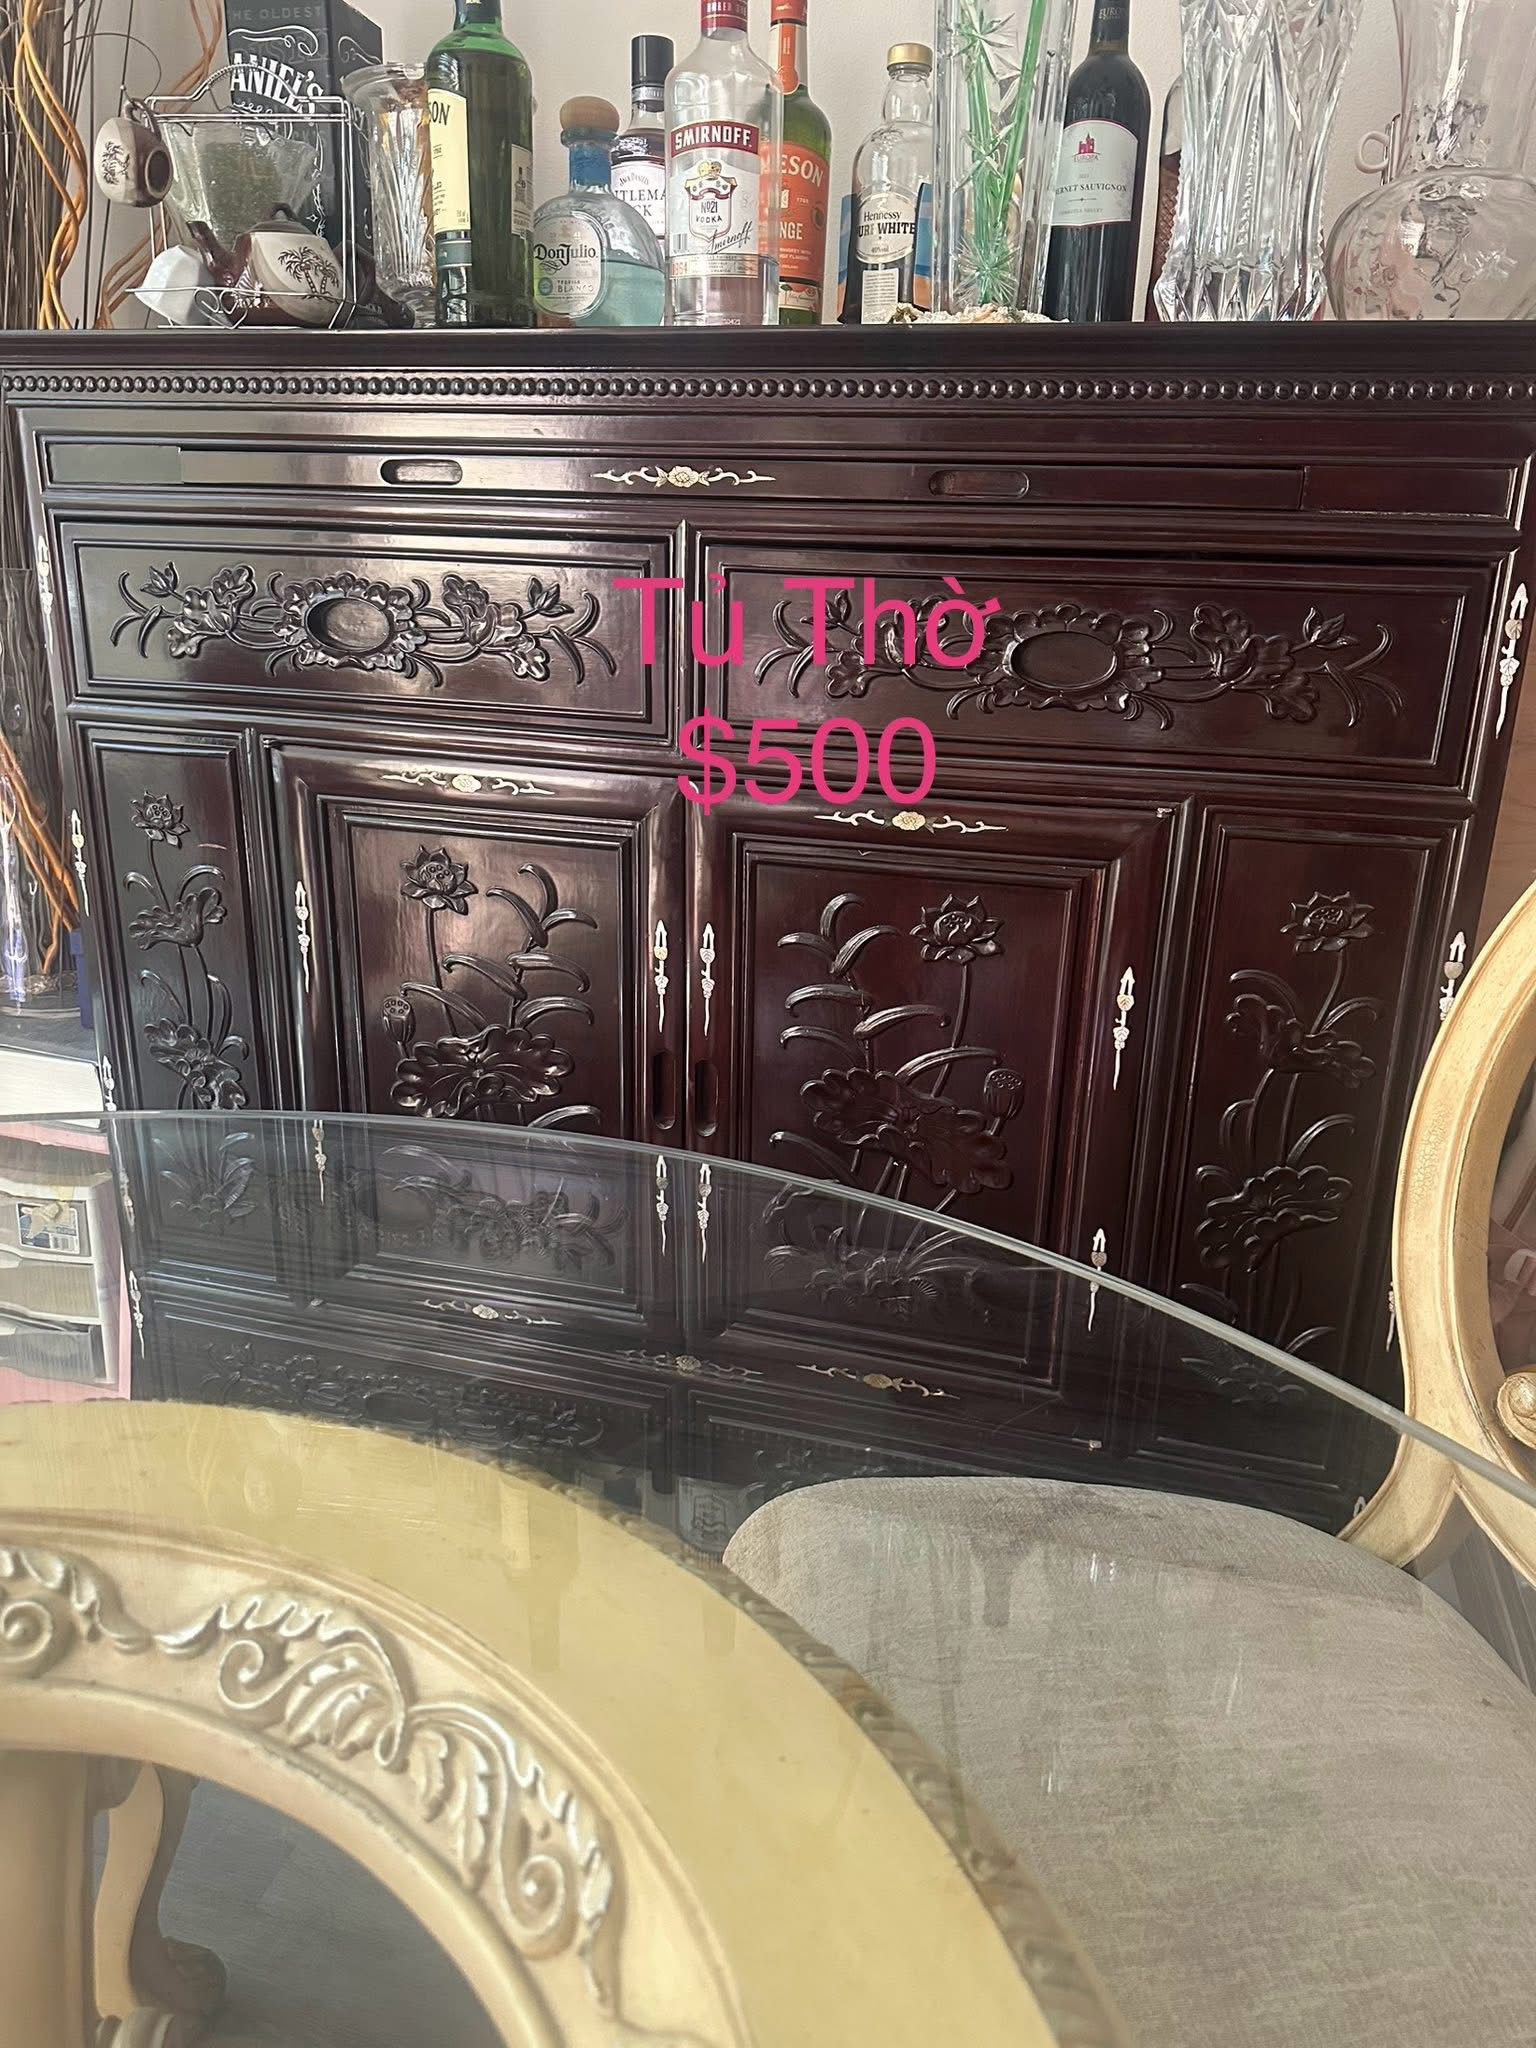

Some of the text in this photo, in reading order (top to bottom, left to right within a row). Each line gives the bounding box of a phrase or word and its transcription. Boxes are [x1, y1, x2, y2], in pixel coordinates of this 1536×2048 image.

[233, 6, 322, 20] HE OLDEST
[230, 53, 324, 120] ANIEL'S
[675, 125, 751, 150] SMIRNOFF
[781, 154, 823, 188] ESON
[1080, 183, 1127, 192] SAUVIGNON
[696, 215, 722, 223] VODKA
[863, 211, 902, 222] Hennessy
[780, 221, 803, 240] NGE
